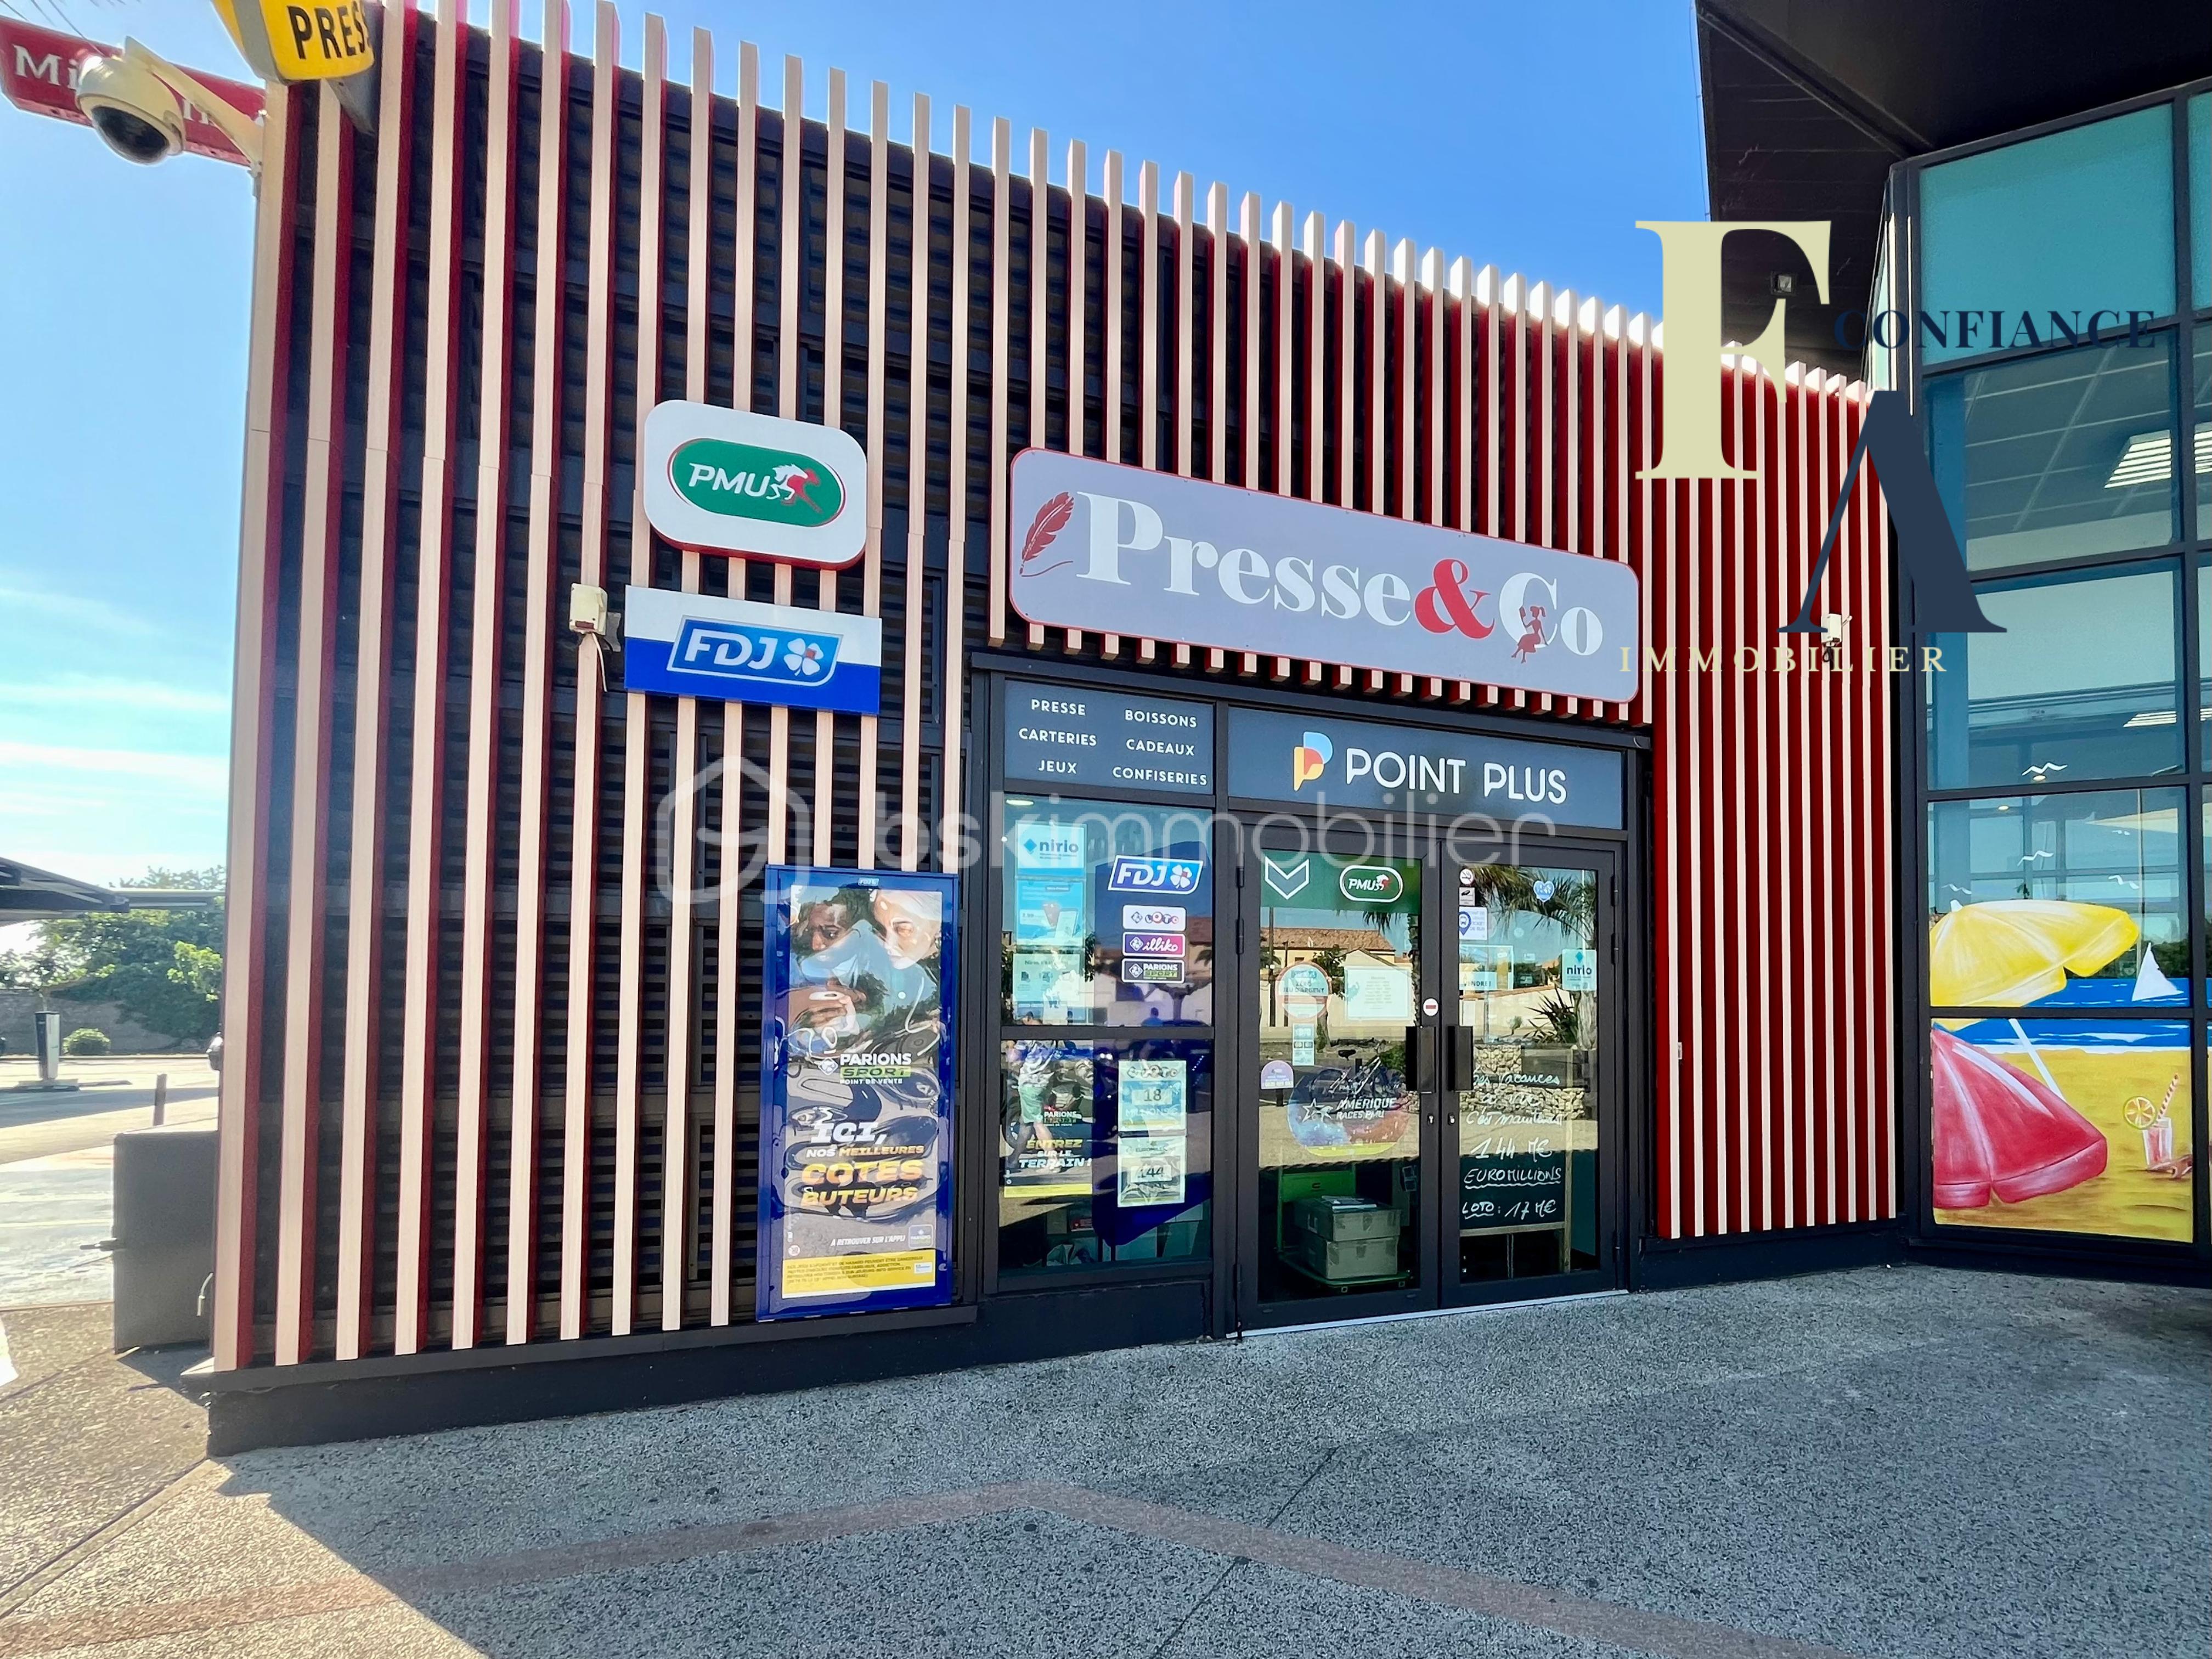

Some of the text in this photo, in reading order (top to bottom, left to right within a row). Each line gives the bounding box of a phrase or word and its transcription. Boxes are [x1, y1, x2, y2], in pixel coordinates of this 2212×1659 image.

[286, 1, 370, 59] PRES
[689, 462, 770, 498] PMU
[684, 628, 779, 670] FDJ
[1031, 698, 1086, 716] PRESSE
[1125, 709, 1197, 729] BOISSONS
[1019, 728, 1097, 747] CARTERIES
[1126, 739, 1195, 756] CADEAUX
[1038, 760, 1077, 774] JEUX
[1113, 766, 1207, 786] CONFISERIES
[1346, 747, 1567, 805] POINT PLUS
[1040, 839, 1079, 853] nirio
[1116, 863, 1167, 887] FDJ
[1348, 878, 1374, 891] PMU
[1144, 911, 1179, 924] LOTO
[1142, 936, 1179, 952] illiko
[1567, 964, 1592, 975] nirio
[840, 1053, 912, 1065] PARIONS
[843, 1067, 906, 1076] SPORT
[1144, 1089, 1161, 1101] 18
[806, 1146, 924, 1157] NOS MEILLEURES
[802, 1160, 924, 1186] COTES
[800, 1187, 918, 1206] BUTEURS
